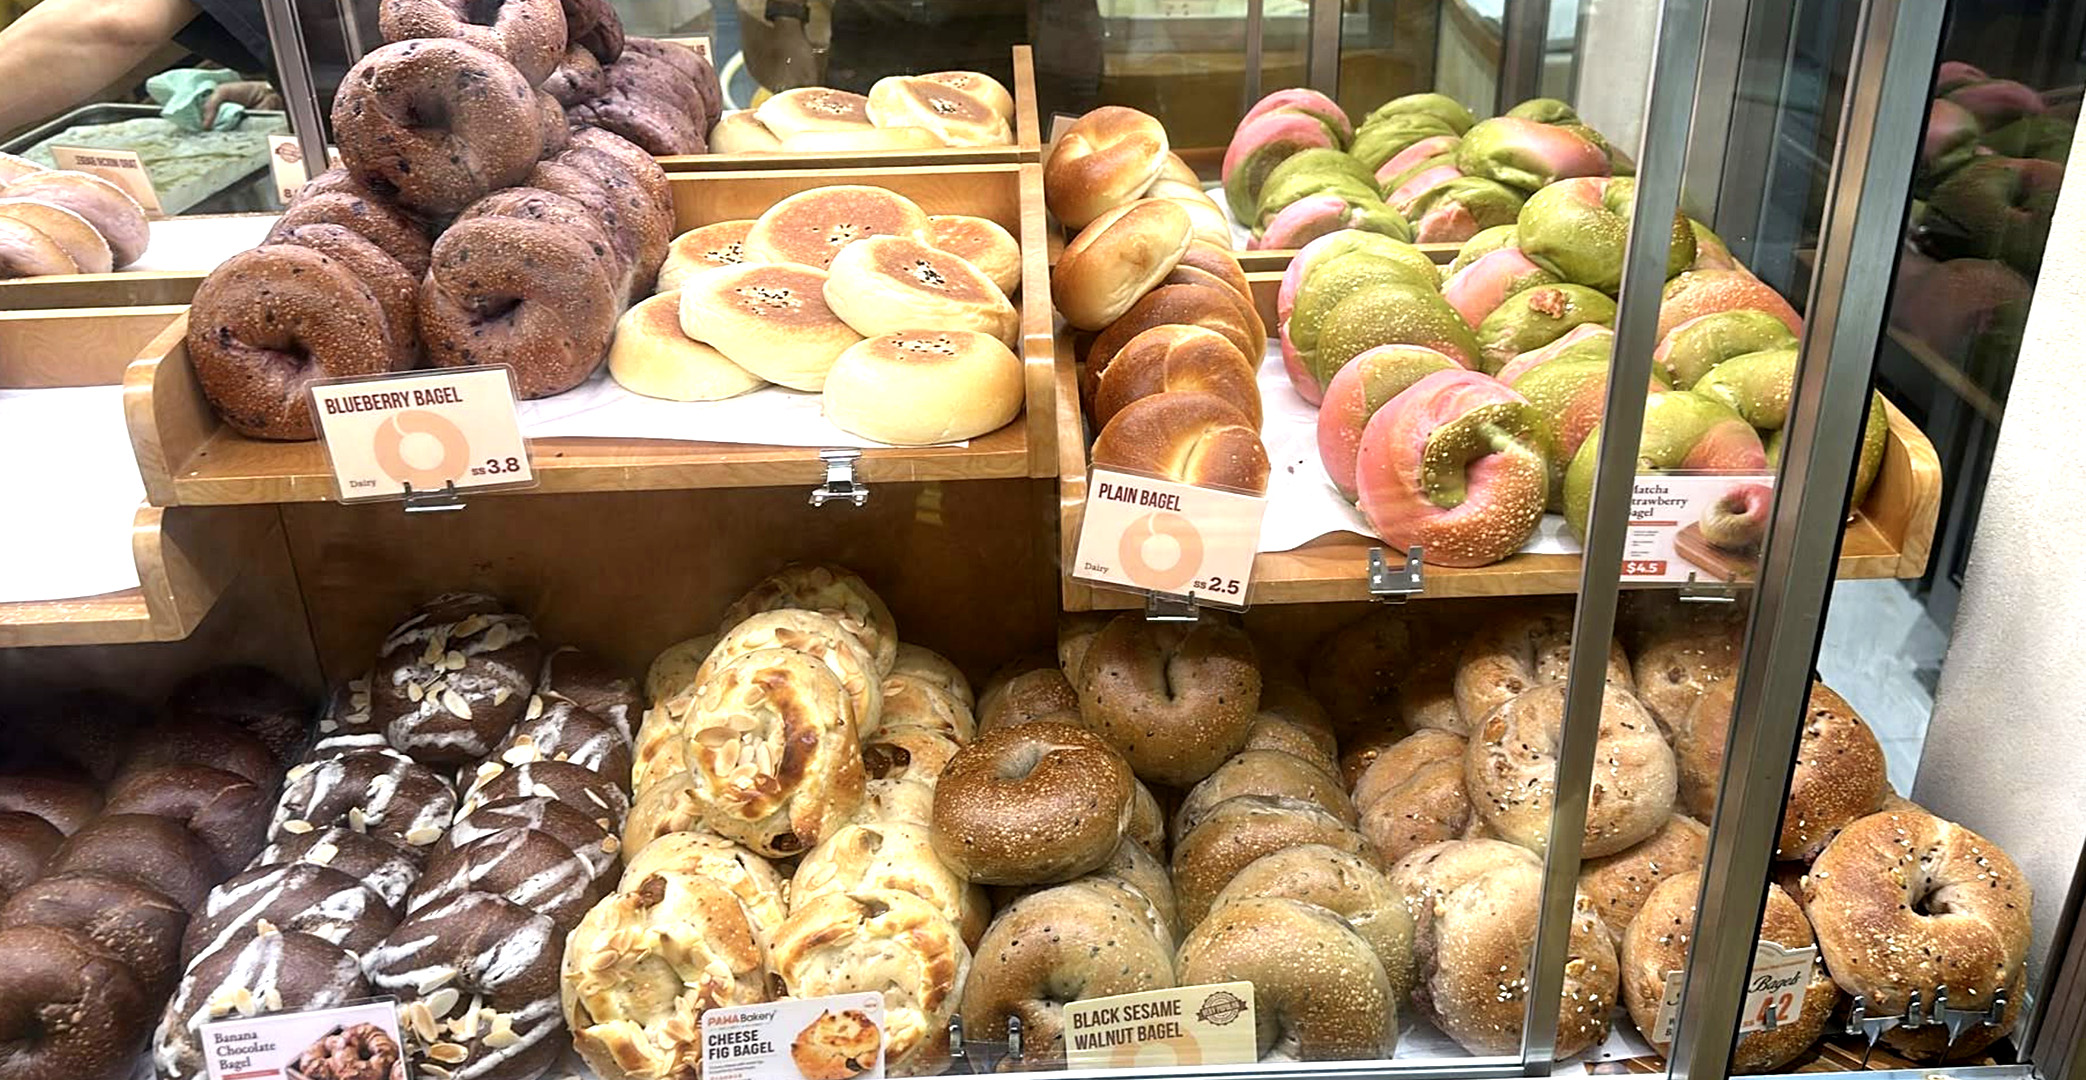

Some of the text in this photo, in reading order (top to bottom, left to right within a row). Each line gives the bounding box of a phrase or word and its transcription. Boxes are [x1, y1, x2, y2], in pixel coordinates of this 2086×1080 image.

[324, 386, 463, 415] BLUEBERRY BAGEL
[486, 457, 520, 474] 3.8
[1098, 483, 1182, 512] PLAIN BAGEL
[1631, 496, 1688, 509] trawberry
[1630, 507, 1654, 520] agel
[1084, 562, 1110, 574] Dairy
[1626, 562, 1659, 574] $4.5
[1208, 576, 1241, 595] 2.5
[1748, 971, 1801, 993] Bagels
[740, 1012, 775, 1022] Bakery
[1073, 1000, 1182, 1030] BLACK SESAME
[214, 1031, 258, 1044] Banana
[708, 1029, 759, 1047] CHEESE
[1074, 1022, 1183, 1050] WALNUT BAGEL
[216, 1041, 276, 1058] Chocolate
[708, 1041, 775, 1060] FIG BAGEL
[219, 1056, 252, 1072] Bagel
